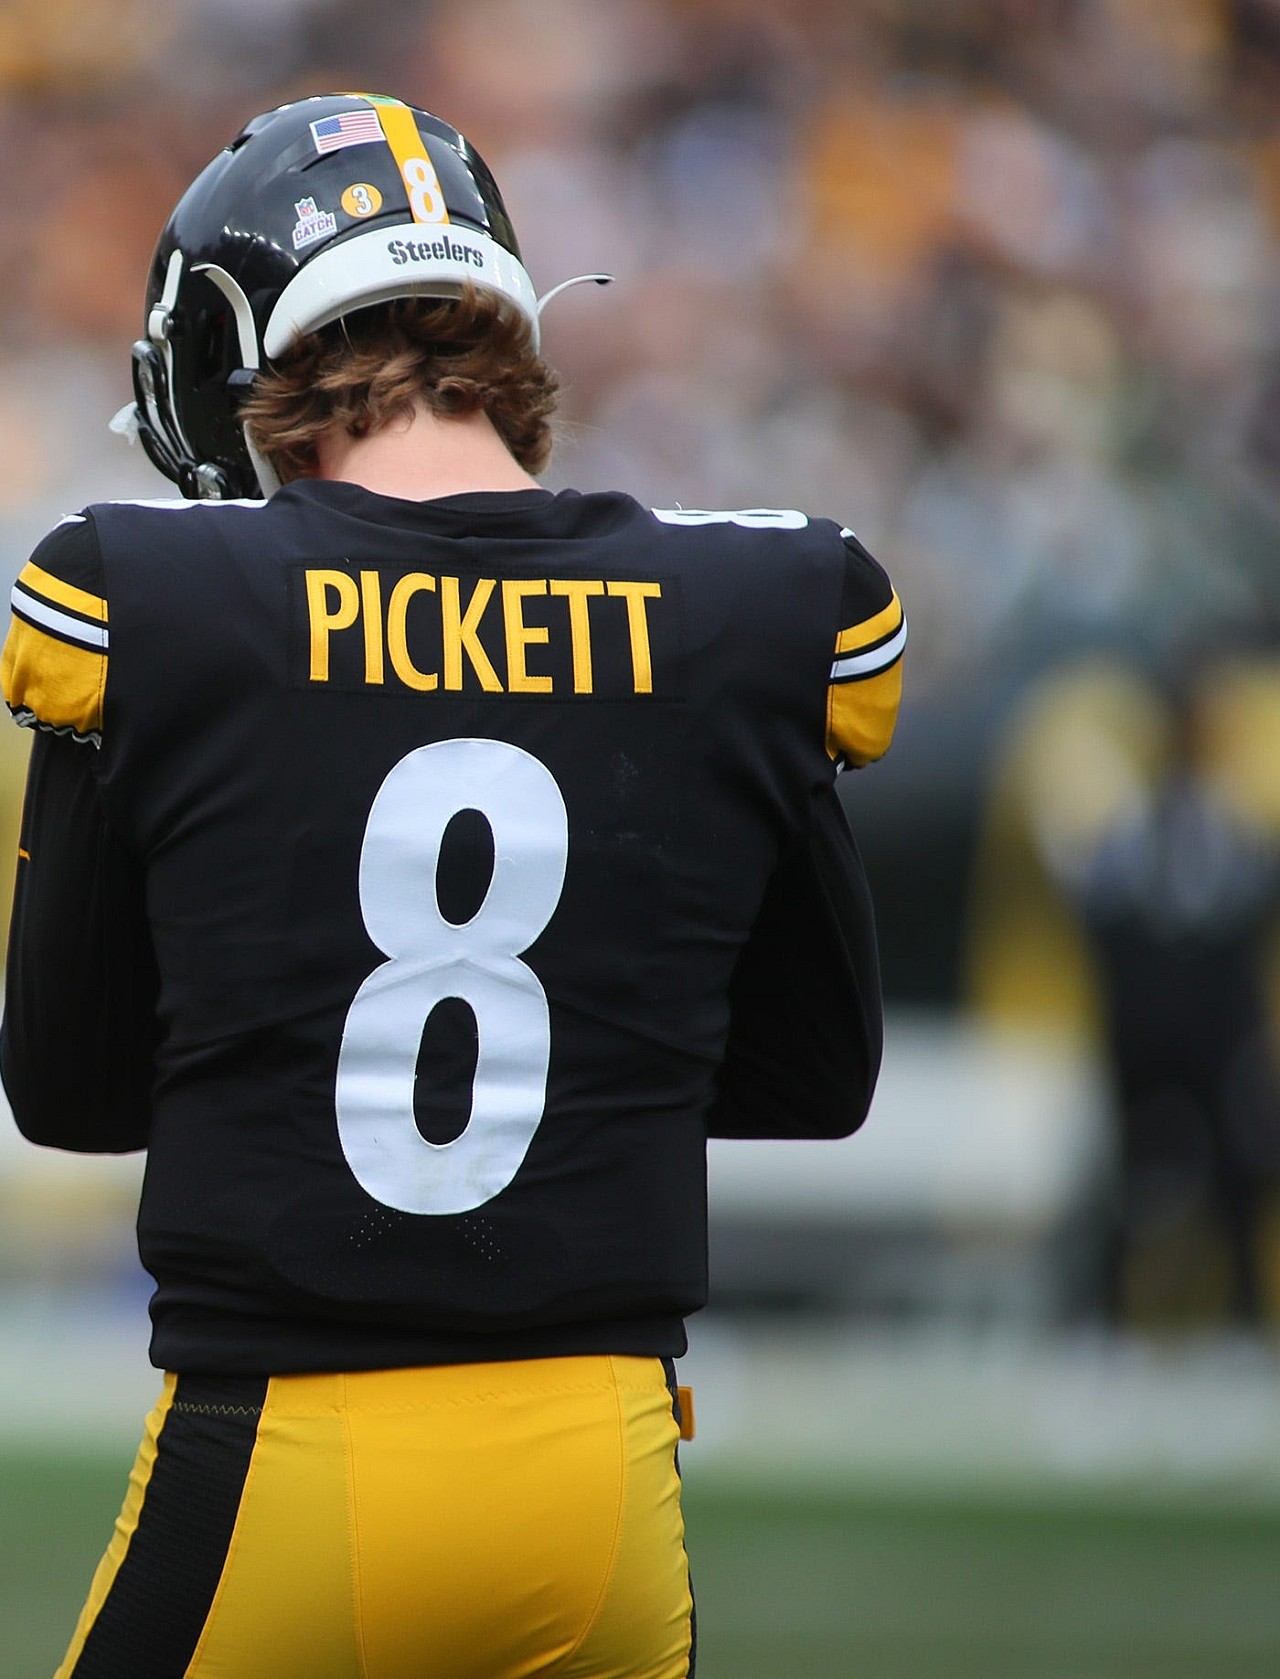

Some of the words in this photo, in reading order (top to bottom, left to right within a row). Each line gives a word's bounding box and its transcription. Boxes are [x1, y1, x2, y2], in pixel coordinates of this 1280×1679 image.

[352, 185, 373, 214] 3
[403, 158, 447, 223] 8
[294, 214, 334, 241] CATCH
[388, 235, 484, 268] Steelers
[305, 570, 661, 694] PICKETT
[335, 738, 568, 1216] 8
